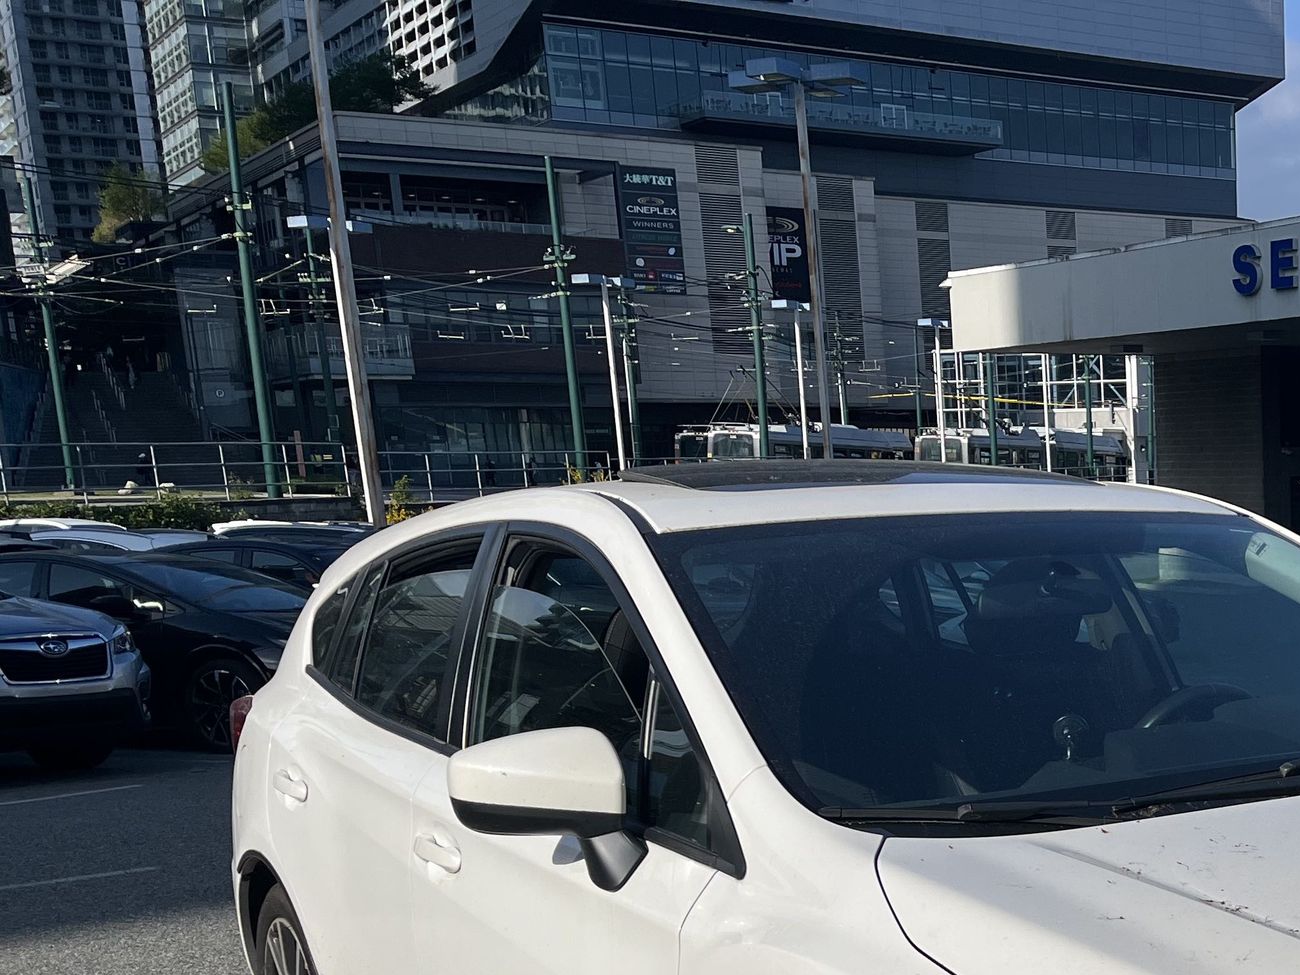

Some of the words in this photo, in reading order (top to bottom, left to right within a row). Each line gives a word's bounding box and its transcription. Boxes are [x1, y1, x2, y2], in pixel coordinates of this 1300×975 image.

[650, 174, 674, 187] T&T
[626, 204, 678, 216] CINEPLEX
[632, 220, 675, 230] WINNERS
[768, 234, 800, 244] EPLEX
